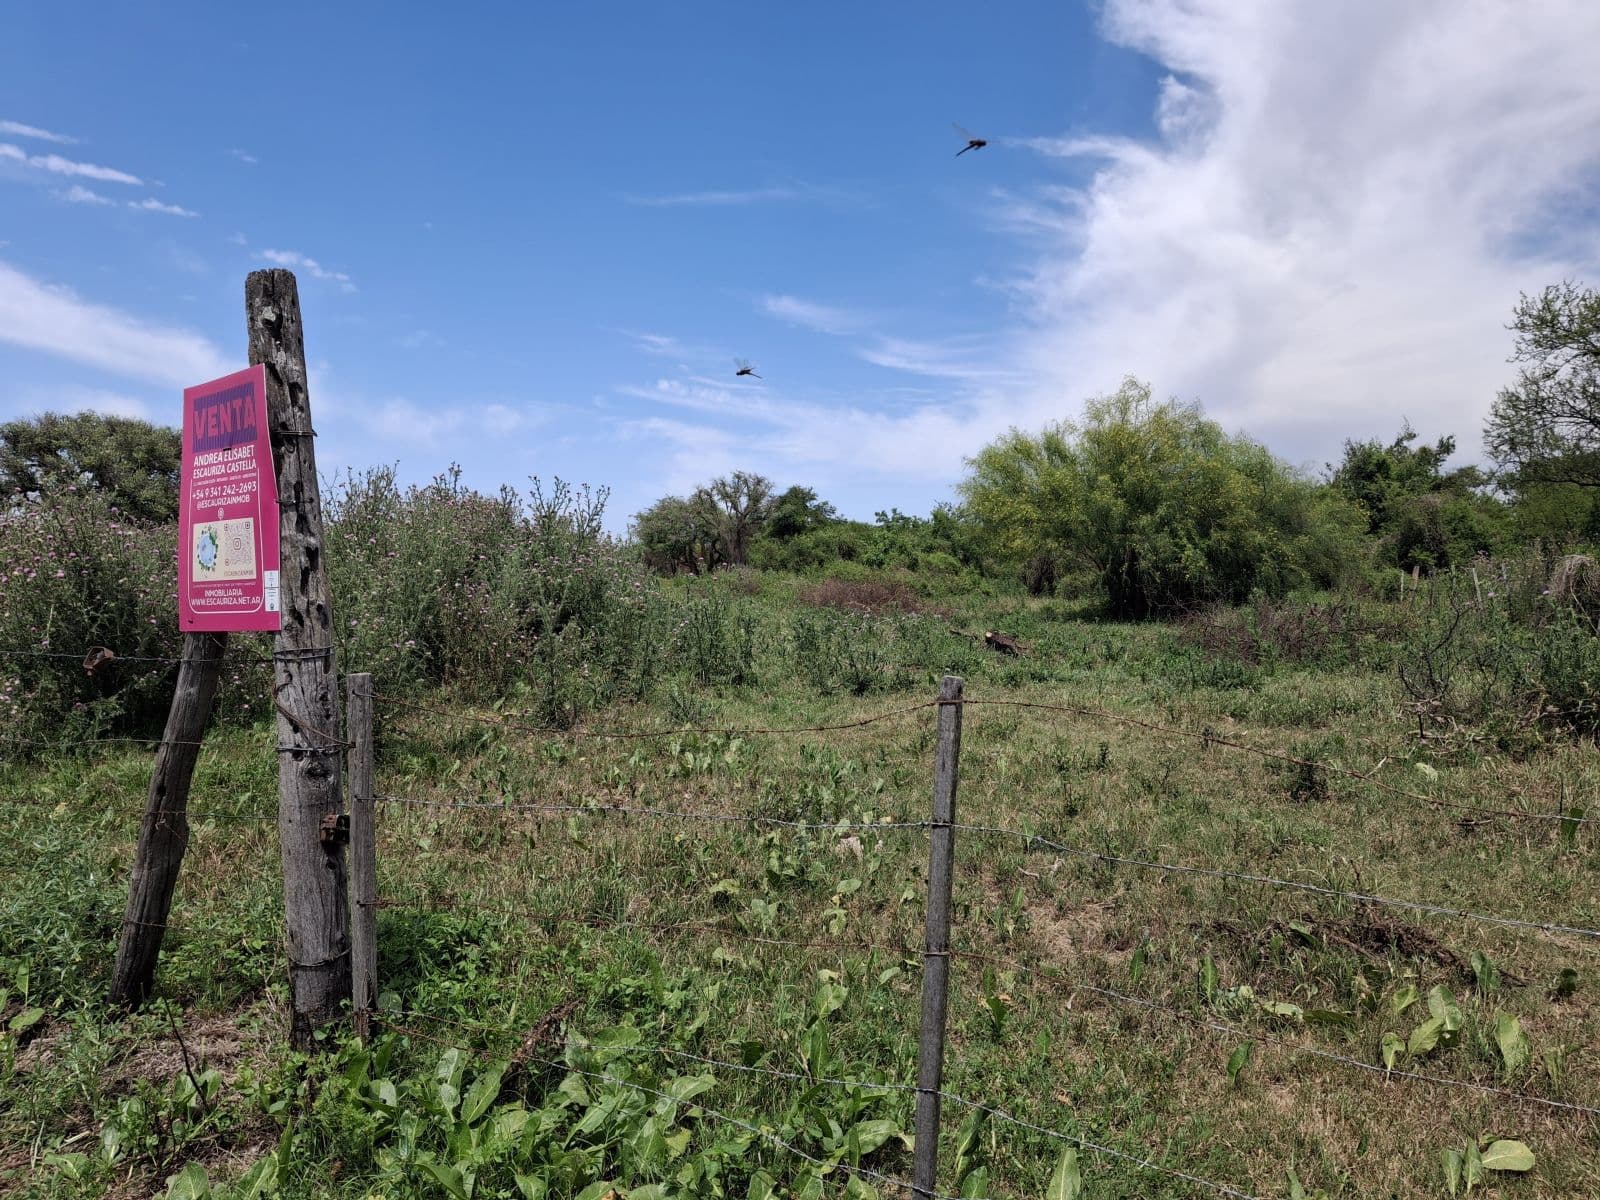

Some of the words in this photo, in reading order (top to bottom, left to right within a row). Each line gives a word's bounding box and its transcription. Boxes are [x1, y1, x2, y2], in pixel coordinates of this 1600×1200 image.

[193, 397, 255, 440] VENTA
[194, 452, 222, 467] ANDREA
[224, 445, 255, 461] ELISABET
[193, 464, 226, 479] ESCAURIZA
[226, 459, 256, 473] CASTELLA
[192, 489, 204, 500] +54
[204, 487, 209, 498] 9
[210, 486, 221, 497] 341
[222, 481, 256, 496] 242-2693
[191, 596, 261, 606] WWW.ESCAURIZA.NET.AR
[204, 588, 243, 597] INMOBILIARIA
